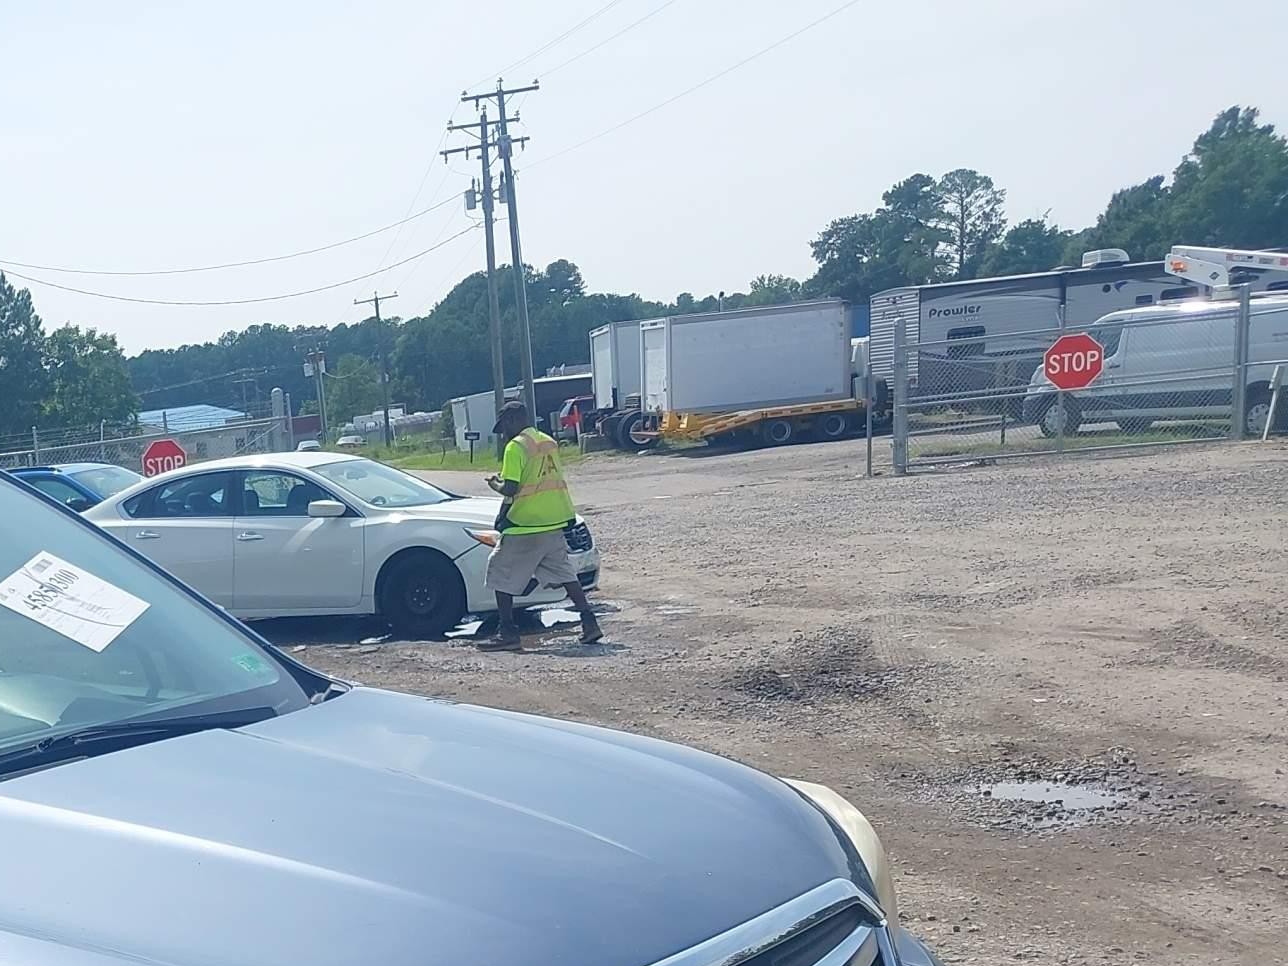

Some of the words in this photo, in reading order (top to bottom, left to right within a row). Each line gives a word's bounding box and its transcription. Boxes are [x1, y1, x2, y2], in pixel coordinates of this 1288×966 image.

[928, 304, 982, 319] Prowler
[1048, 350, 1099, 375] STOP
[146, 455, 184, 477] STOP
[22, 568, 80, 611] 45850300
